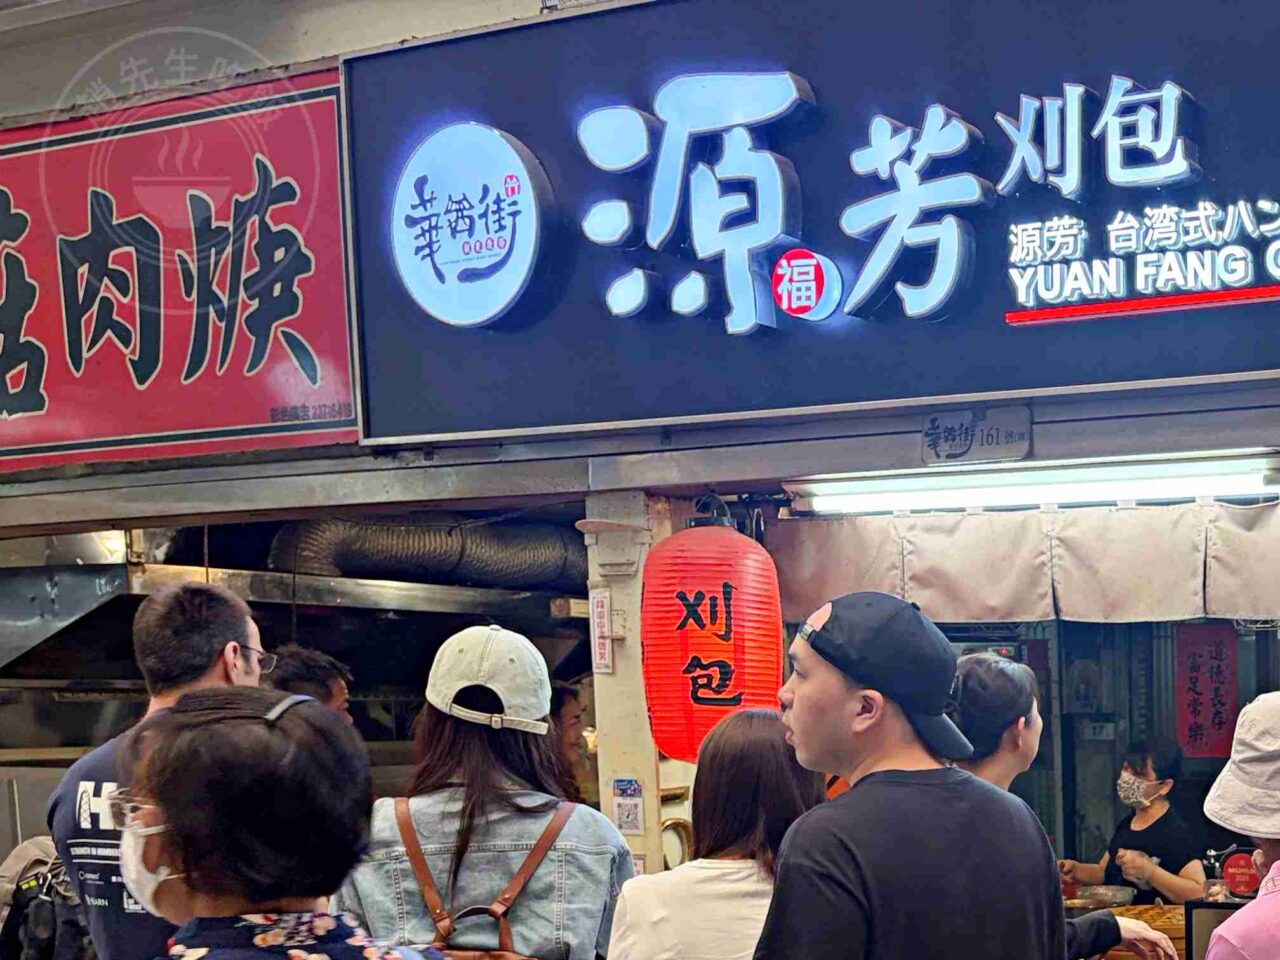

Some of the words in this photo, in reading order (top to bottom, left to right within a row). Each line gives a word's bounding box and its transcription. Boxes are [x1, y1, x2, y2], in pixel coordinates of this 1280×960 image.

[995, 75, 1189, 196] 刈包
[1009, 215, 1081, 264] 源芳
[777, 258, 817, 310] 福
[1009, 257, 1119, 304] YUAN
[1136, 245, 1251, 293] FANG
[979, 427, 1000, 446] 161
[676, 582, 743, 706] 刈包
